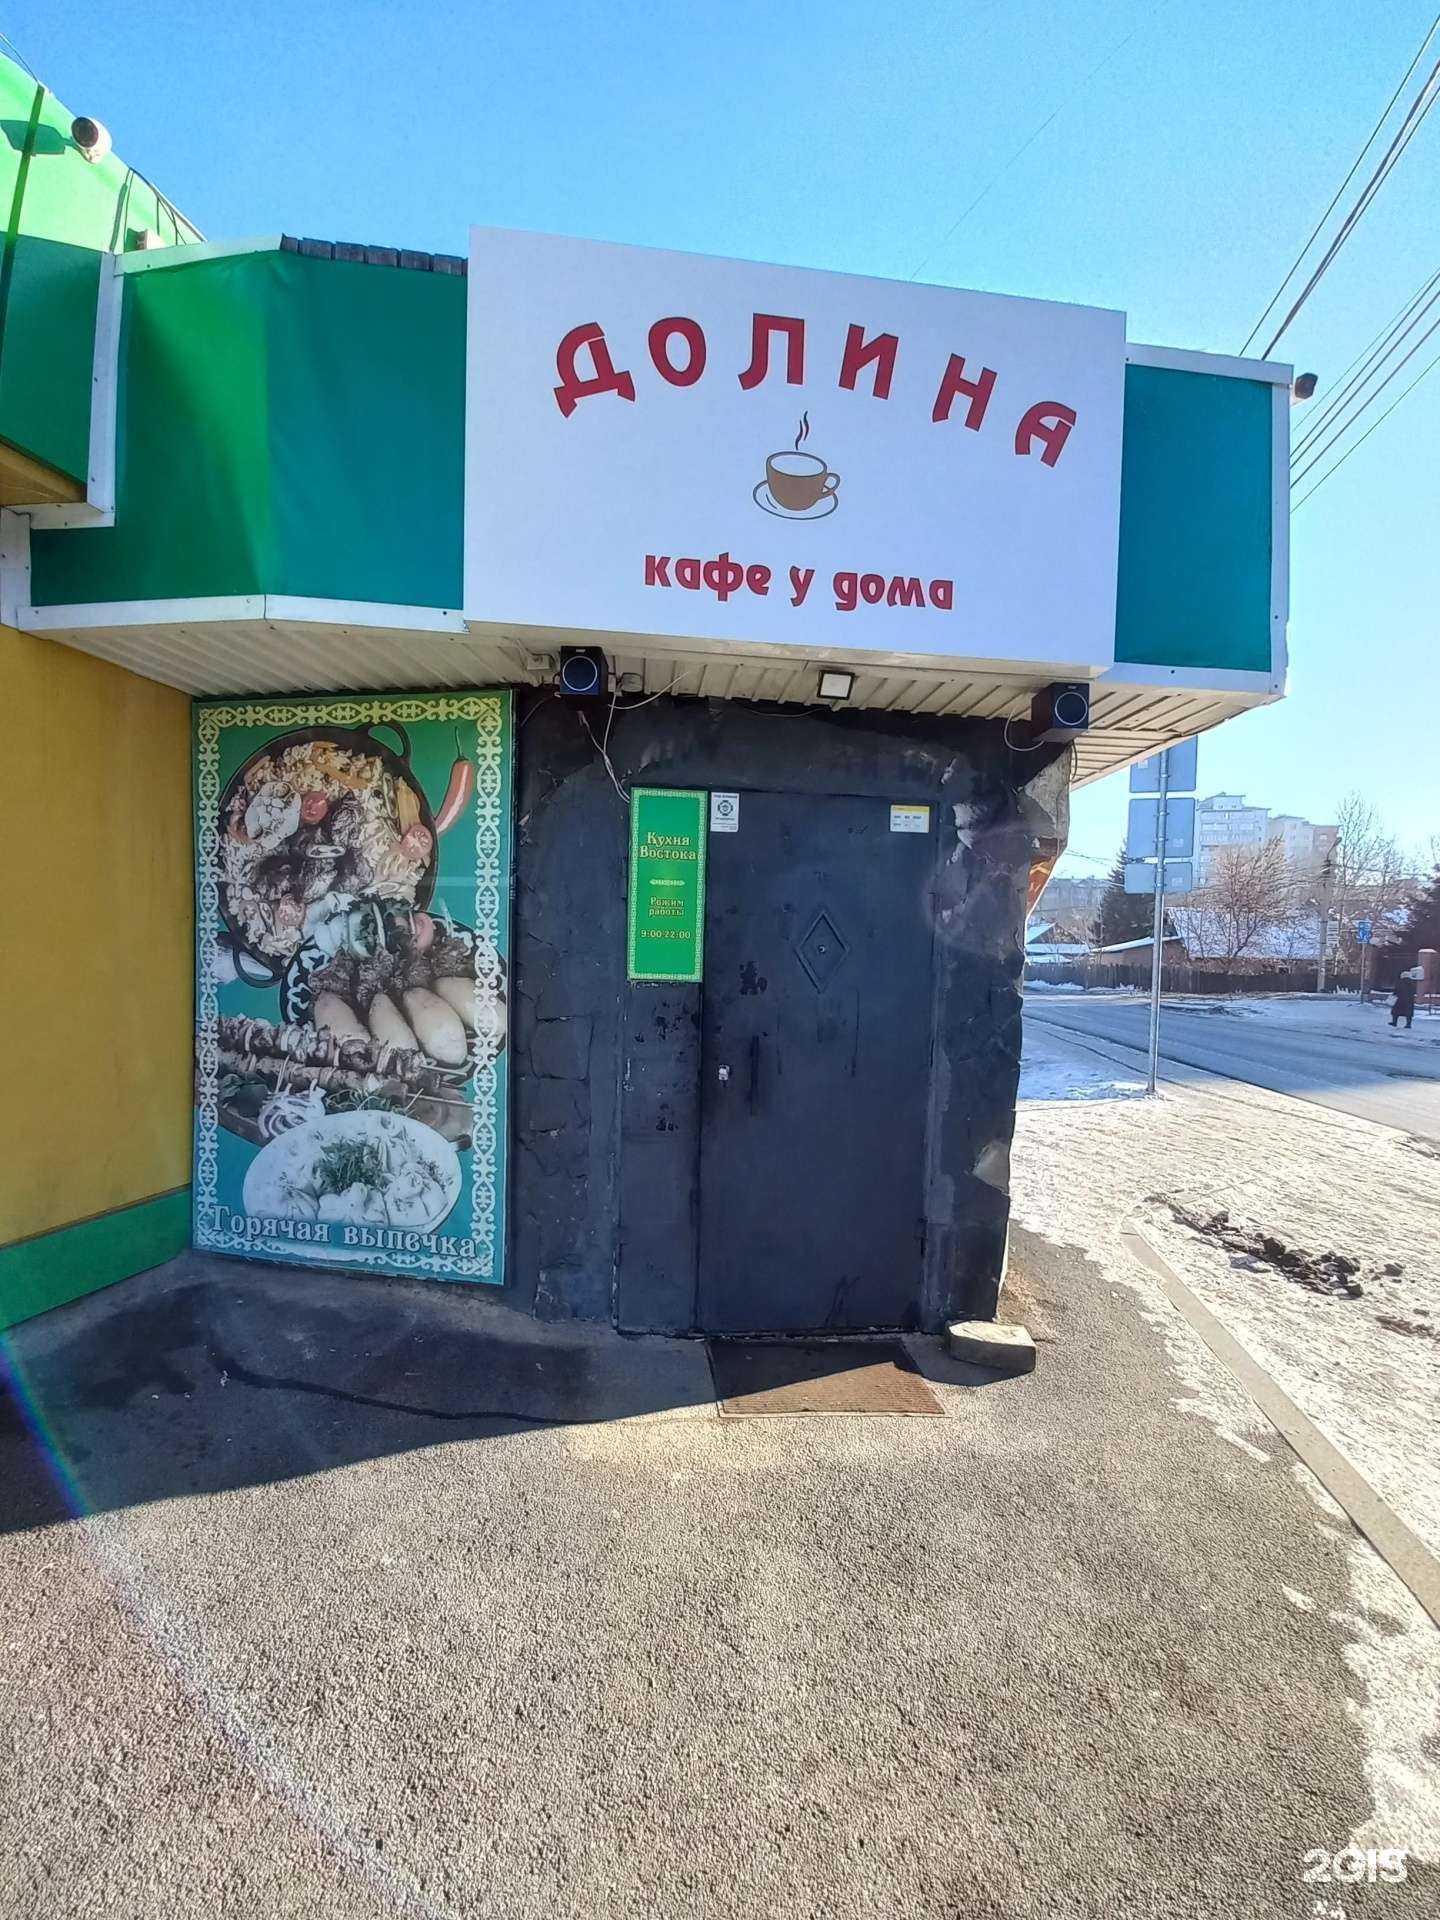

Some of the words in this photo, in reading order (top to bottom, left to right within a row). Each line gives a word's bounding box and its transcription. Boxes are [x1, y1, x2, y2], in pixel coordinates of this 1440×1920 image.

[553, 312, 1077, 468] ДОЛИНА
[644, 551, 771, 602] кафе
[789, 565, 815, 607] у
[832, 572, 954, 612] дома
[640, 845, 697, 860] Востока
[647, 831, 690, 848] Кухня
[648, 907, 684, 917] работы
[210, 1203, 331, 1243] Горячая
[342, 1222, 478, 1259] выпечка
